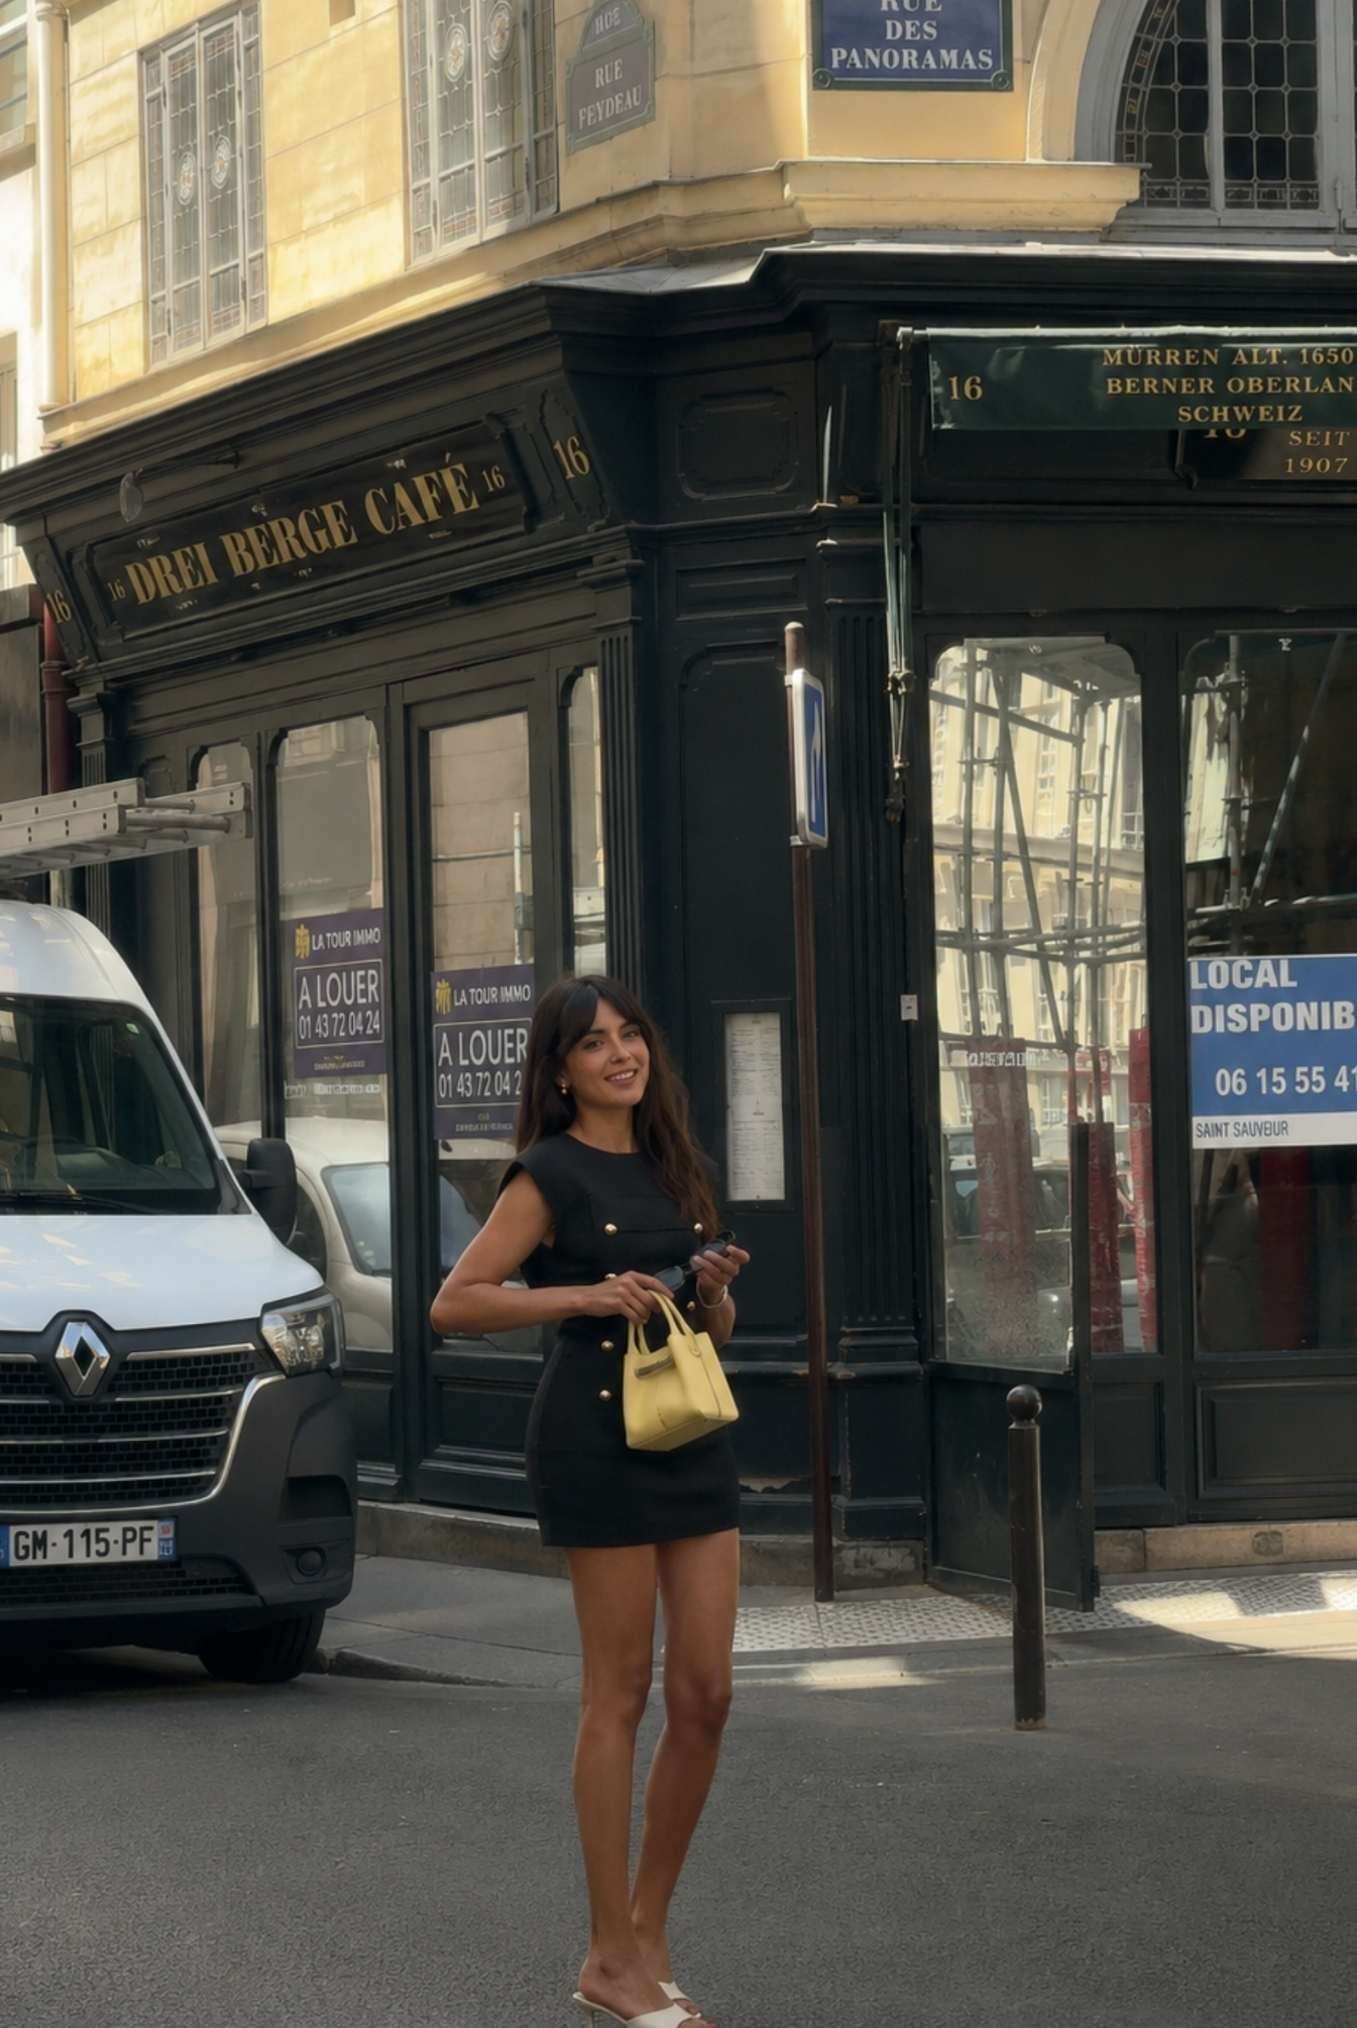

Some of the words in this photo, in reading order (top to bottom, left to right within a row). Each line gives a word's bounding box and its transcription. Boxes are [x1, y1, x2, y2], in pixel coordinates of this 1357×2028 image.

[886, 20, 937, 40] DES
[595, 58, 623, 88] RUE
[831, 48, 993, 69] PANORAMAS
[579, 84, 642, 130] FEYDEAU
[1232, 349, 1287, 365] ALT.
[1301, 348, 1354, 364] 1650
[948, 376, 983, 400] 16
[1107, 377, 1215, 394] BERNER
[1227, 377, 1353, 394] OBERLAN
[1178, 405, 1303, 422] SCHWEIZ
[1288, 431, 1350, 446] SEIT
[553, 435, 590, 481] 16
[1285, 457, 1349, 474] 1907
[107, 578, 126, 601] 16
[125, 542, 218, 605] DREI
[219, 500, 358, 577] BERGE
[364, 452, 480, 535] CAFÉ
[482, 465, 505, 492] 16
[46, 590, 72, 624] 16
[312, 934, 325, 950] LA
[326, 931, 351, 949] TOUR
[353, 928, 381, 946] IMMO
[1190, 959, 1298, 989] LOCAL
[299, 976, 312, 1010] A
[317, 970, 379, 1008] LOUER
[454, 989, 468, 1006] LA
[469, 986, 498, 1005] TOUR
[500, 984, 531, 1003] IMMO
[299, 1015, 312, 1039] 01
[315, 1013, 329, 1038] 43
[332, 1012, 346, 1037] 72
[348, 1011, 363, 1036] 04
[366, 1009, 380, 1034] 24
[1191, 1001, 1355, 1034] DISPONIB
[438, 1031, 453, 1067] A
[459, 1028, 528, 1066] LOUER
[439, 1074, 453, 1098] 01
[457, 1072, 473, 1097] 43
[476, 1071, 491, 1096] 72
[494, 1070, 510, 1096] 04
[1215, 1067, 1247, 1096] 06
[1256, 1067, 1286, 1094] 15
[1295, 1066, 1326, 1093] 55
[1196, 1122, 1229, 1138] SAINT
[1233, 1120, 1288, 1137] SAUVEUR
[14, 1526, 154, 1560] GM-115-PF
